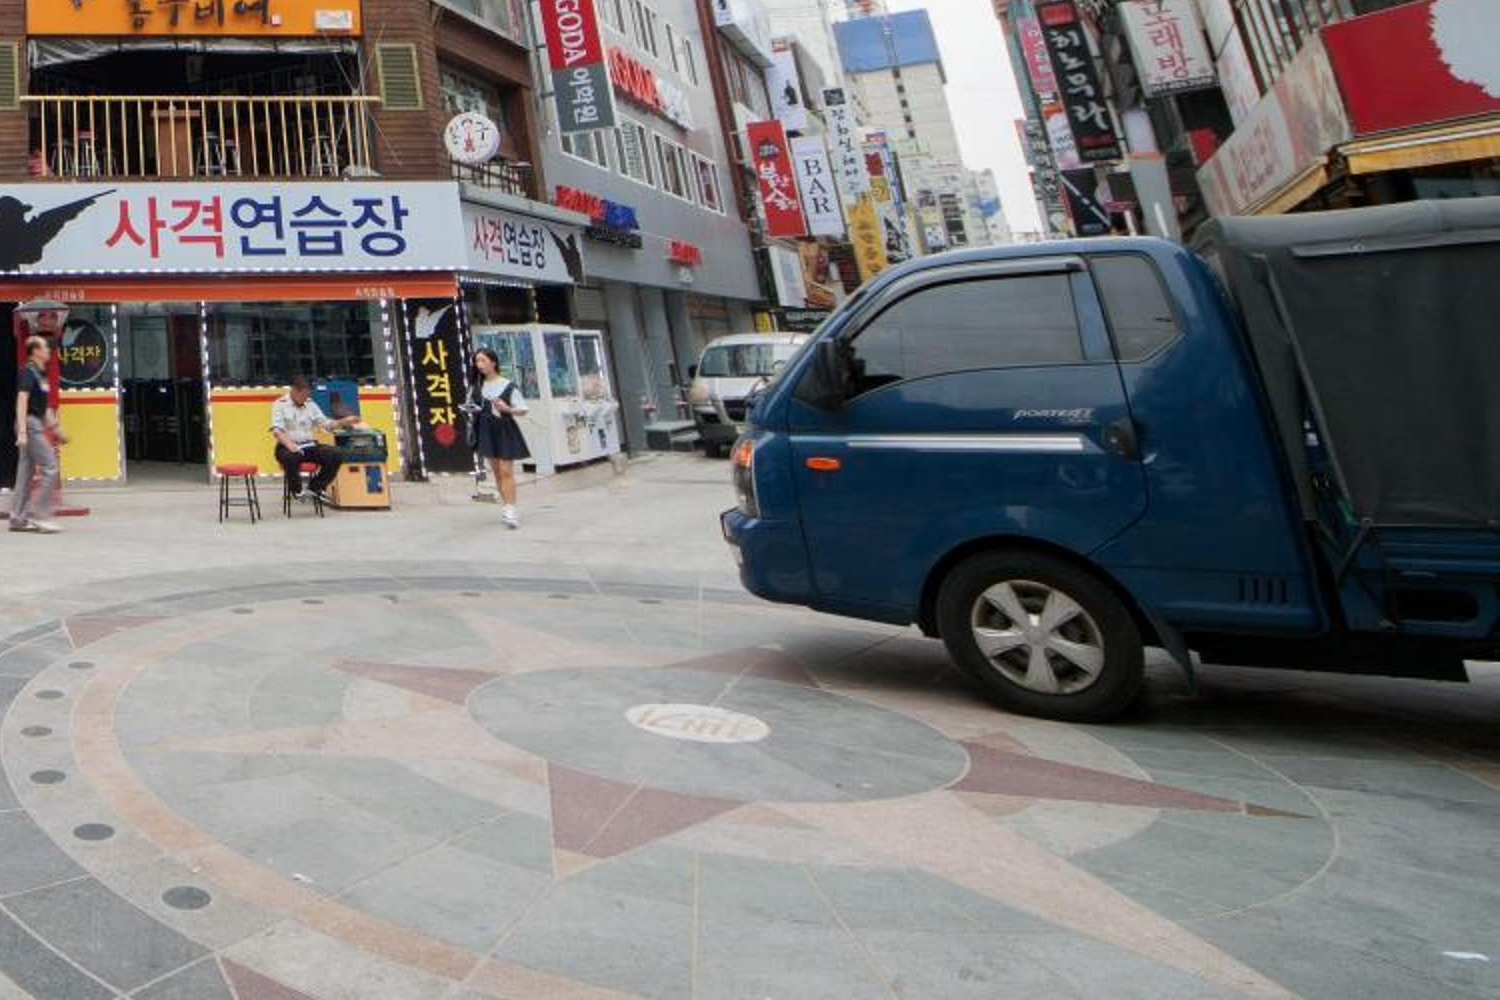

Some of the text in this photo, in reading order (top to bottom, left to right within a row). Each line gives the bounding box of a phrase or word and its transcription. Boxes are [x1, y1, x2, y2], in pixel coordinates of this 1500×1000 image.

[568, 67, 599, 123] 어학원
[802, 158, 833, 215] BAR
[106, 196, 409, 261] 사격연습장
[473, 215, 546, 270] 사격연습장
